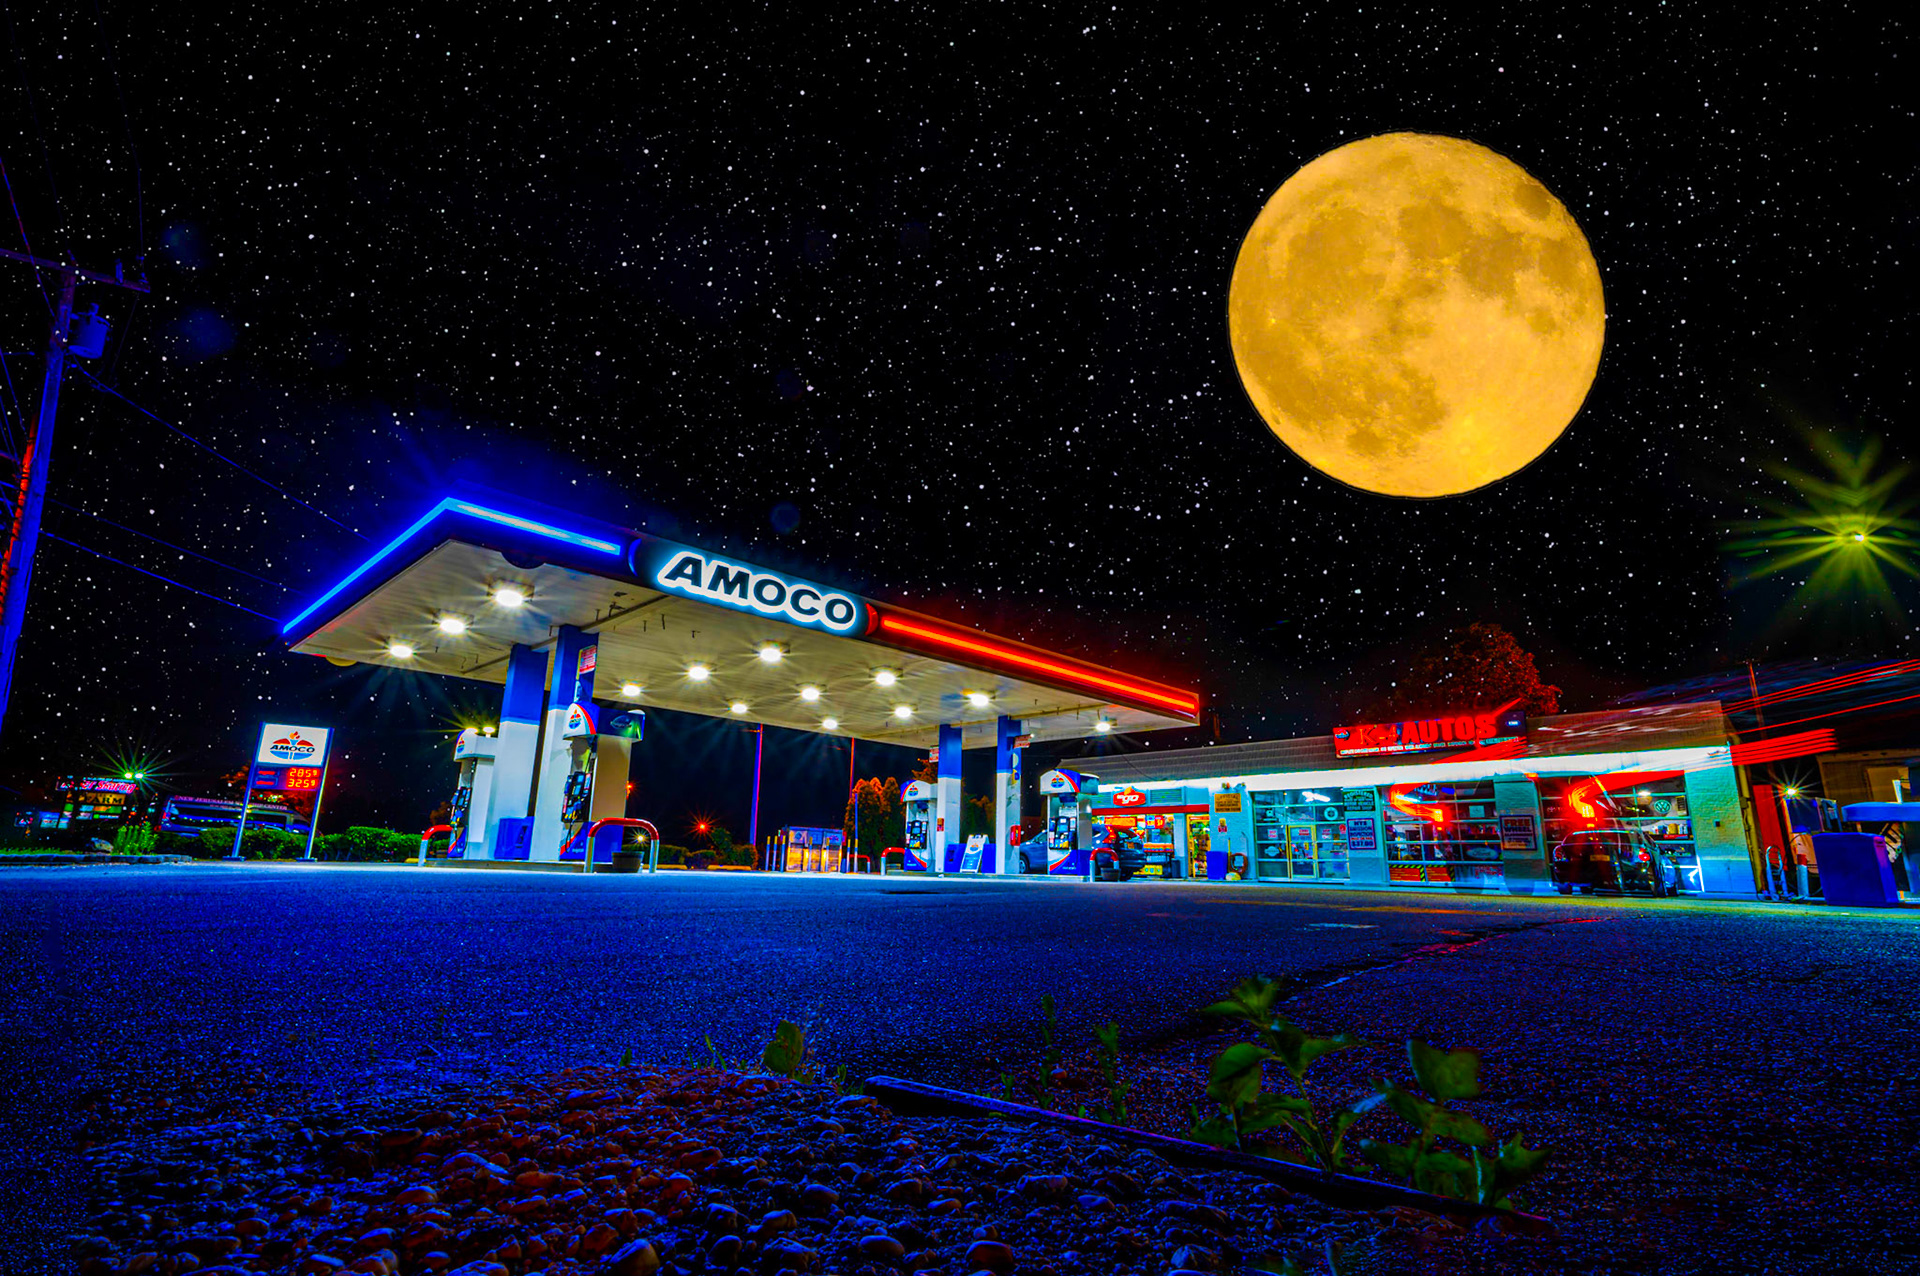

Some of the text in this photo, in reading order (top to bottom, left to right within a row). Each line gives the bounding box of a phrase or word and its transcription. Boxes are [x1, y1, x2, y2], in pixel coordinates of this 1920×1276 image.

[663, 555, 855, 626] AMOCO
[1401, 714, 1498, 745] AUTOS
[269, 744, 316, 754] AMOCO
[264, 803, 288, 811] CENTER
